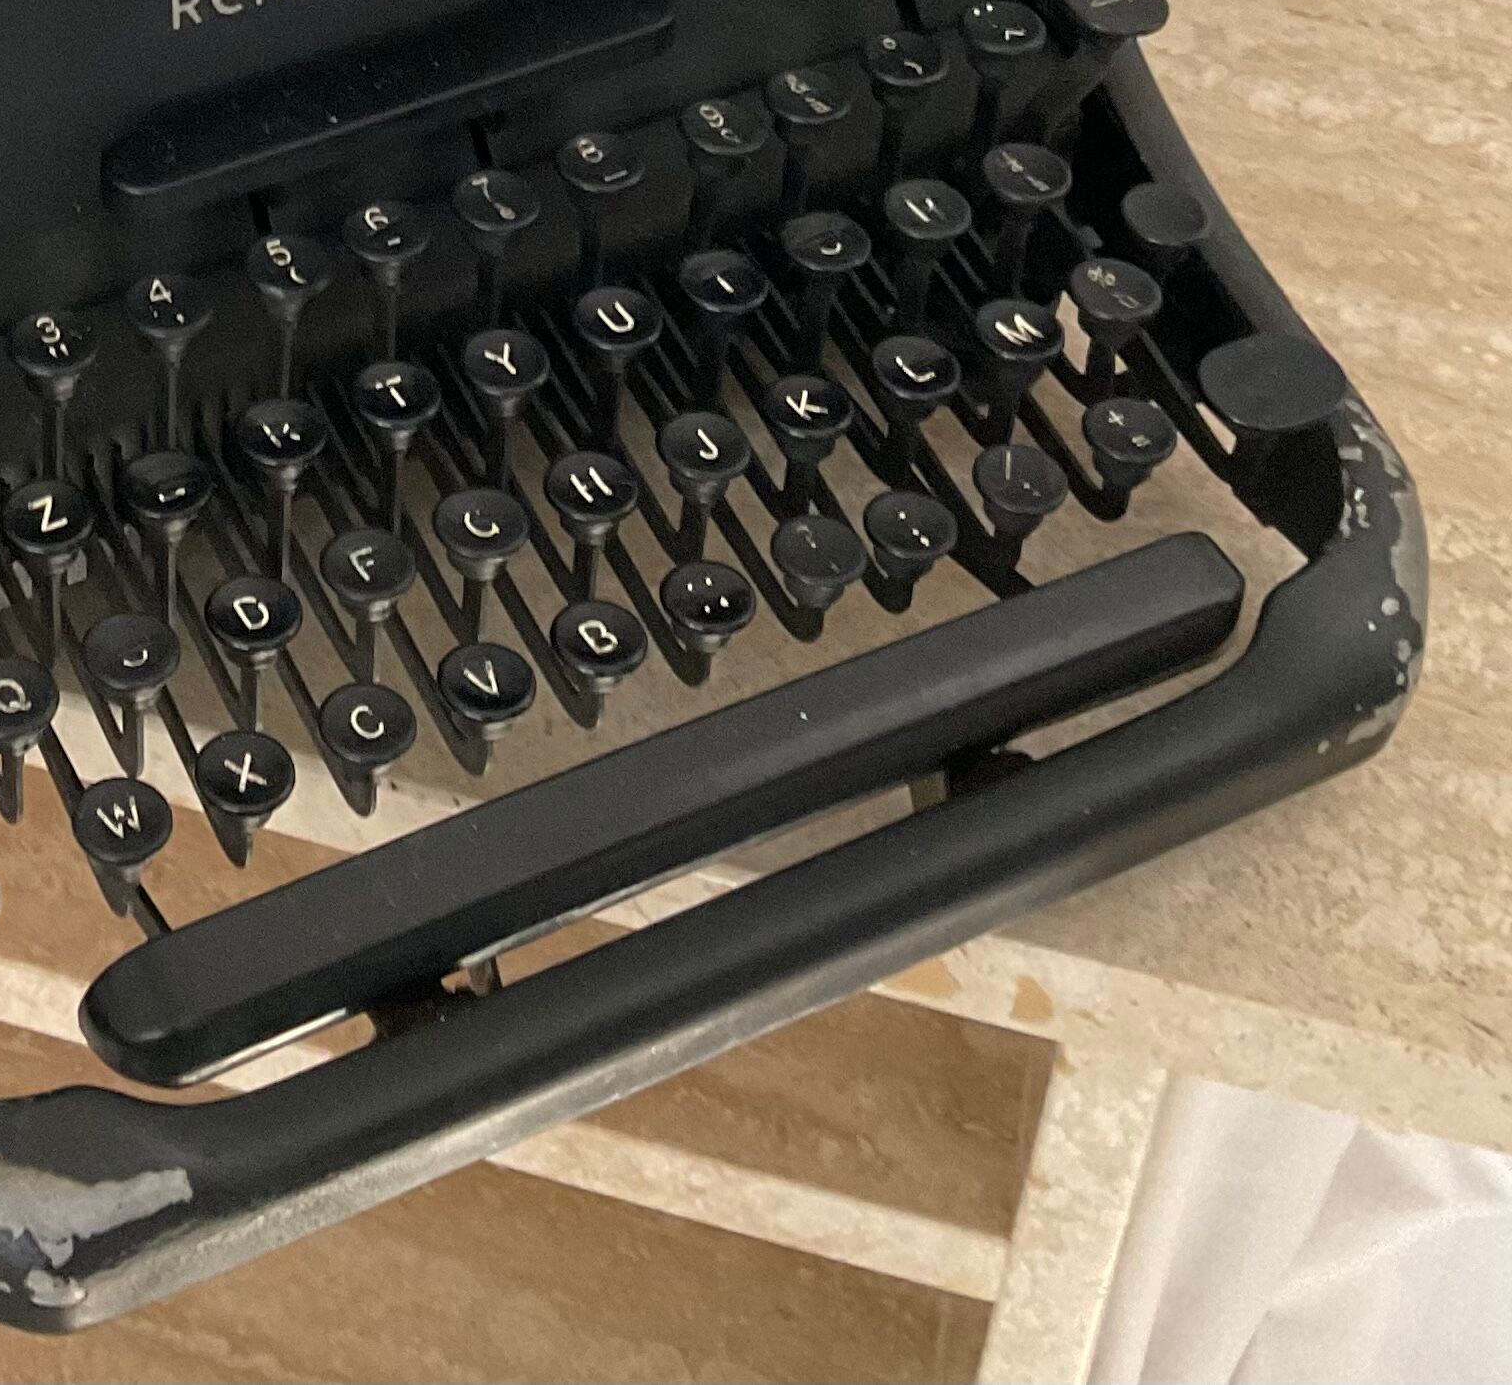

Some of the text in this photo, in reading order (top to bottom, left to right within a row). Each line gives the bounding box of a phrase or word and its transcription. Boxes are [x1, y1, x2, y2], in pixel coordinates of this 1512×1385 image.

[700, 105, 723, 127] 9
[266, 239, 291, 265] 5
[150, 279, 171, 302] 4
[37, 317, 60, 343] 3
[598, 301, 634, 332] U
[995, 314, 1042, 343] M
[485, 343, 516, 374] Y
[896, 356, 935, 382] L
[375, 375, 405, 406] T
[786, 390, 827, 419] K
[698, 429, 718, 459] J
[571, 467, 612, 502] H
[28, 495, 67, 532] Z
[350, 546, 374, 581] F
[233, 596, 269, 629] D
[578, 620, 617, 653] B
[464, 661, 498, 694] V
[351, 705, 384, 738] C
[224, 753, 266, 792] X
[97, 797, 139, 837] W
